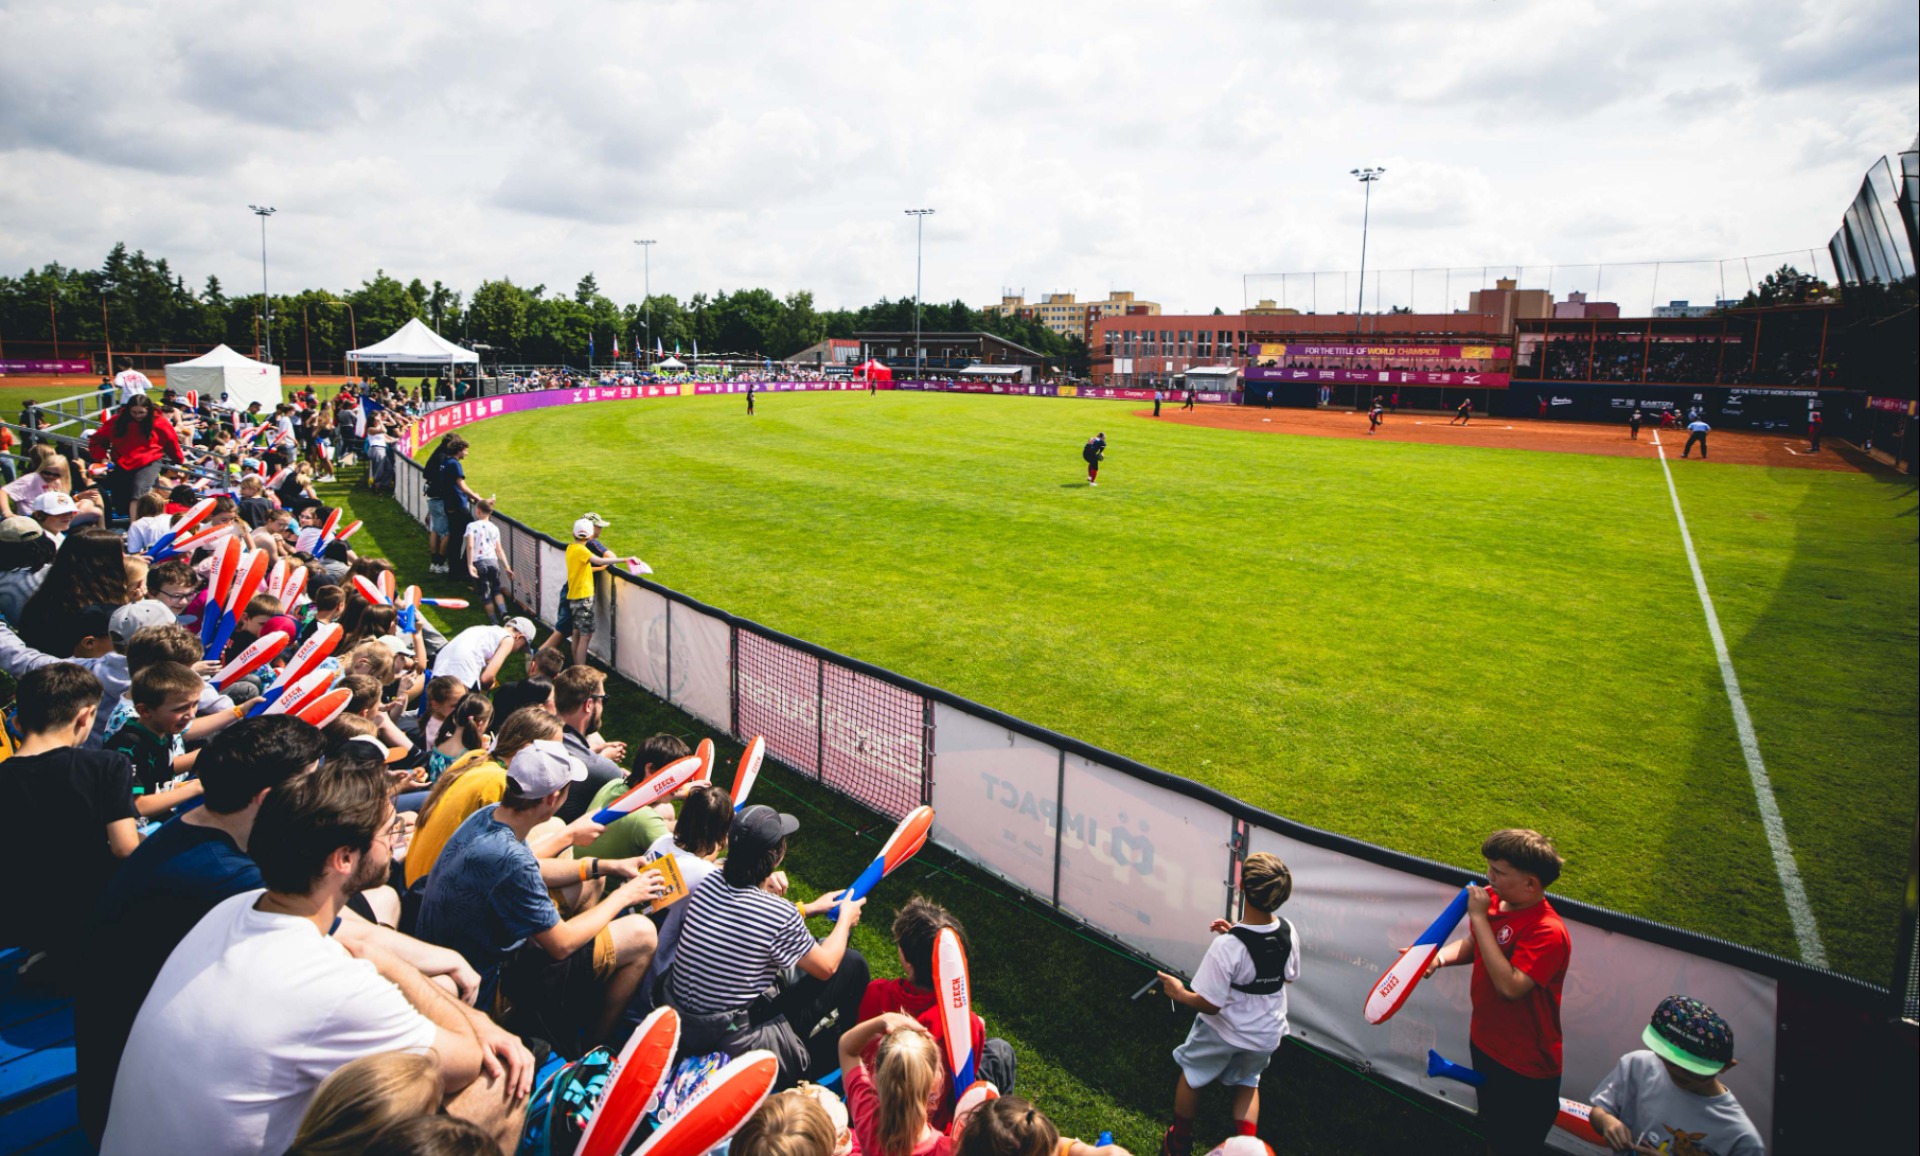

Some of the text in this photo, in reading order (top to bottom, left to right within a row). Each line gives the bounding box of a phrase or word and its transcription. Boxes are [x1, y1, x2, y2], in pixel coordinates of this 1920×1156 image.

[1305, 347, 1440, 356] FOR THE TITLE OF WORLD CHAMPION
[1125, 390, 1144, 398] Corpay
[239, 646, 257, 661] CZECH
[298, 640, 315, 659] CZECH
[280, 687, 302, 705] CZECH
[751, 756, 761, 774] CZECH
[654, 776, 675, 793] CZECH
[953, 977, 963, 1009] CZECH
[1379, 976, 1400, 998] CZECH
[1666, 1023, 1704, 1045] MINECRAFT
[598, 1064, 623, 1108] SOFTBALL
[672, 1087, 710, 1121] SOFTBALL
